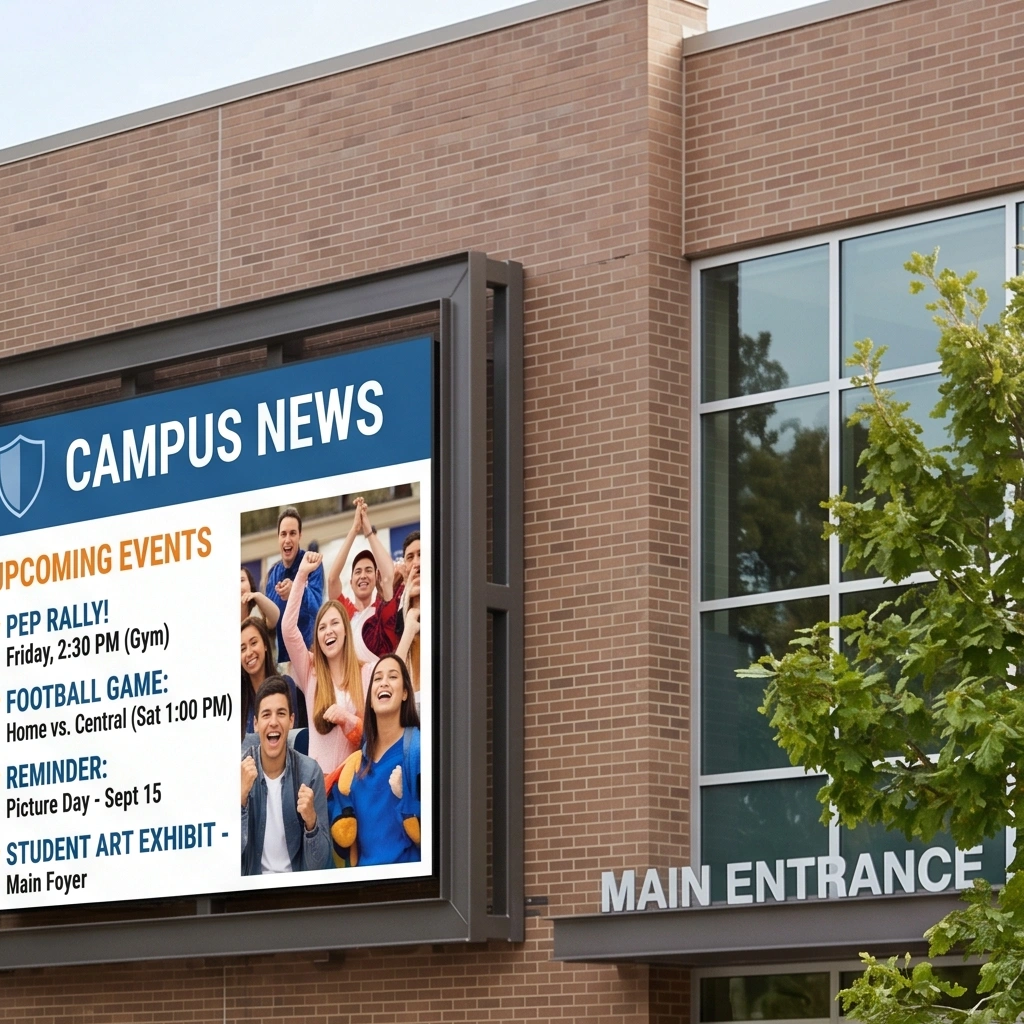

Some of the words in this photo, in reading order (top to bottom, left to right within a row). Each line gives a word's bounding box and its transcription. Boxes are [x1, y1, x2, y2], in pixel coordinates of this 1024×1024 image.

[65, 408, 243, 493] CAMPUS
[257, 379, 385, 457] NEWS
[119, 526, 212, 572] EVENTS
[6, 610, 42, 639] PEP
[46, 599, 109, 633] RALLY!
[6, 642, 55, 668] Friday,
[57, 637, 91, 660] 2:30
[95, 630, 120, 655] PM
[124, 622, 170, 656] (Gym)
[6, 679, 102, 714] FOOTBALL
[106, 669, 169, 701] GAME:
[6, 723, 47, 743] Home
[50, 720, 71, 738] vs.
[74, 709, 127, 735] Central
[131, 703, 162, 734] (Sat
[165, 699, 198, 724] 1:00
[202, 692, 233, 720] PM)
[6, 755, 108, 790] REMINDER:
[6, 795, 59, 819] Picture
[62, 791, 91, 817] Day
[104, 786, 139, 810] Sept
[143, 781, 162, 805] 15
[6, 836, 91, 867] STUDENT
[95, 829, 135, 858] ART
[139, 821, 217, 854] EXHIBIT
[6, 872, 42, 895] Main
[46, 870, 88, 896] Foyer
[601, 864, 711, 913] MAIN
[726, 844, 984, 905] ENTRANCE
